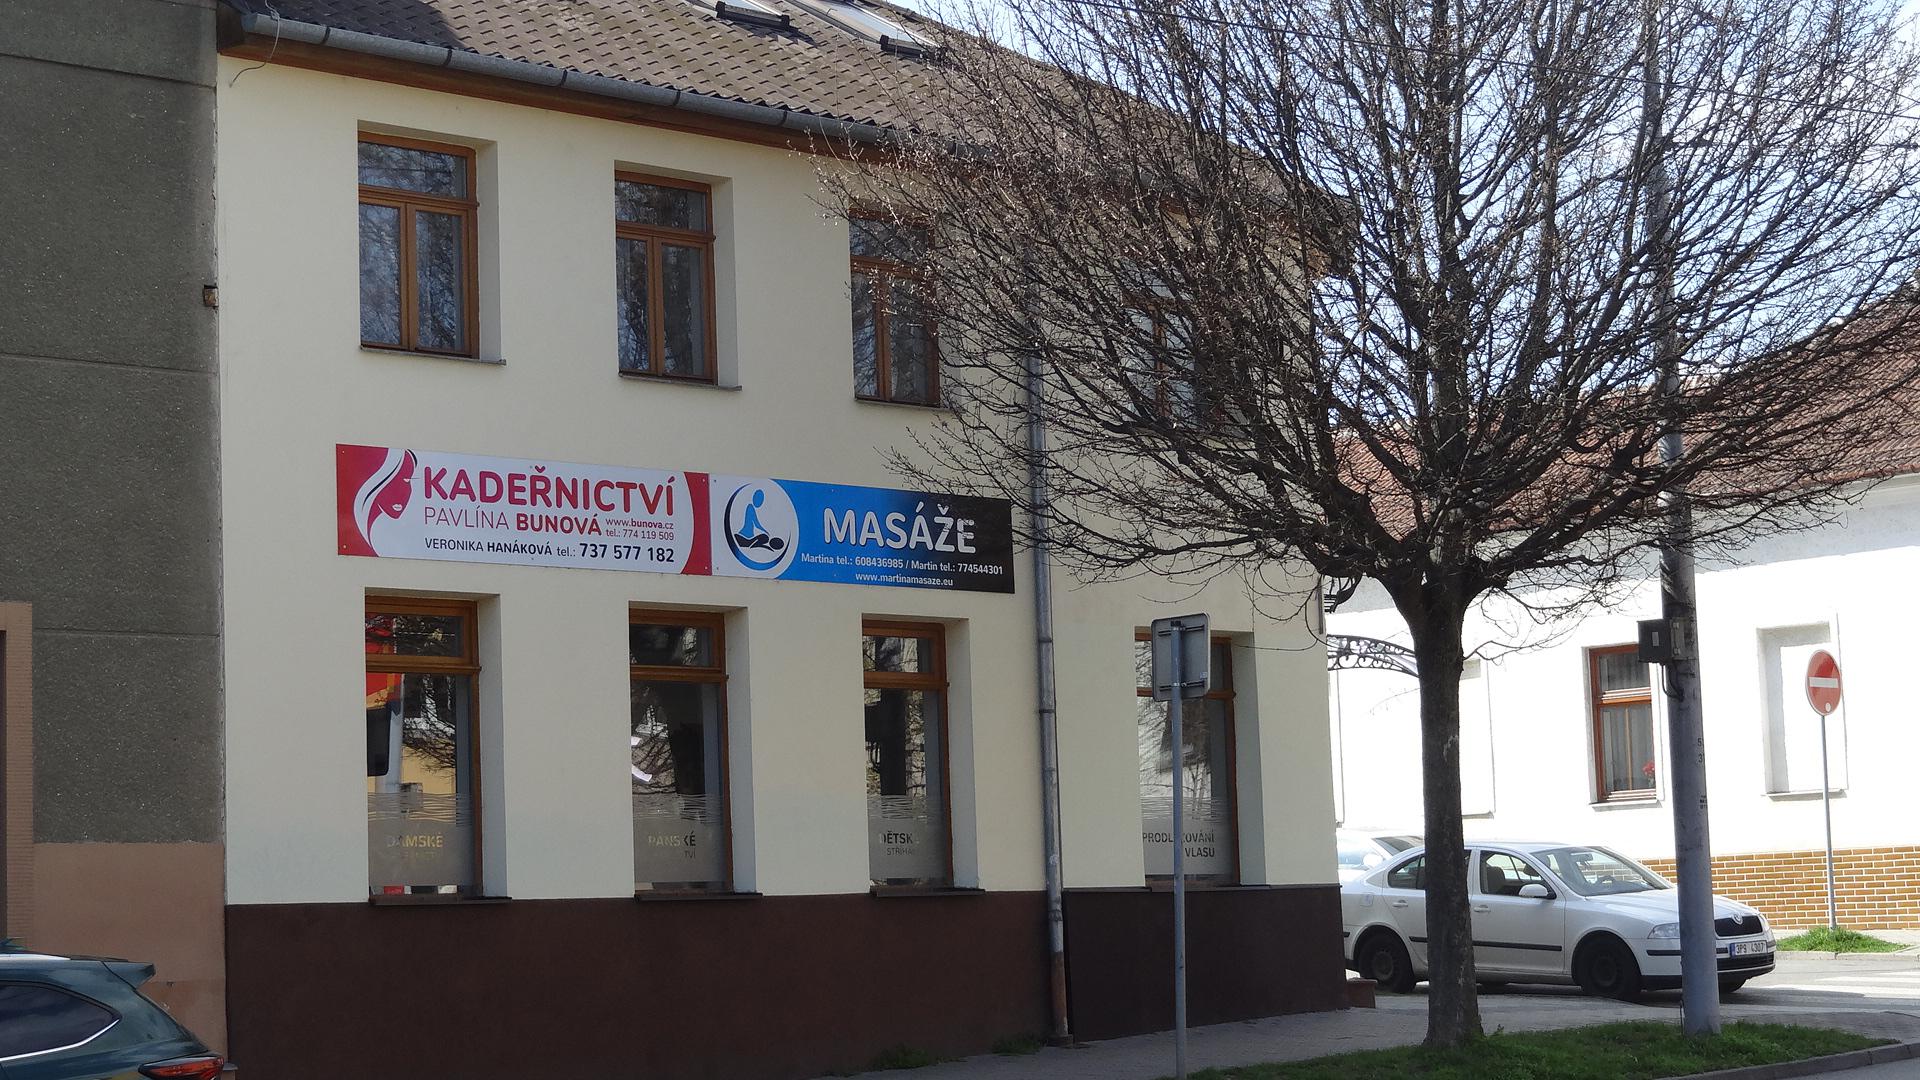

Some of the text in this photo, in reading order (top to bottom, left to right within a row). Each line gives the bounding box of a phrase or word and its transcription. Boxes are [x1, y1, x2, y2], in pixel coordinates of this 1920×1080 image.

[424, 465, 675, 516] KADEŘNICTVÍ
[424, 505, 602, 536] PAVLÍNA BUNOVÁ
[605, 517, 674, 530] www.bunova.cz
[823, 501, 976, 554] MASÁŽE
[605, 529, 675, 541] tel.: 774 119 509
[424, 537, 675, 562] VERONIKA HANÁKOVÁ tel.: 737 577 182
[801, 552, 835, 564] Martina
[836, 555, 853, 565] tel.:
[854, 556, 904, 569] 608436985
[911, 560, 939, 571] Martin
[939, 562, 956, 572] tel.:
[957, 563, 1003, 575] 774544301
[855, 573, 954, 586] www.martinamasaze.eu
[1142, 829, 1215, 843] PRODLOVÁNÍ
